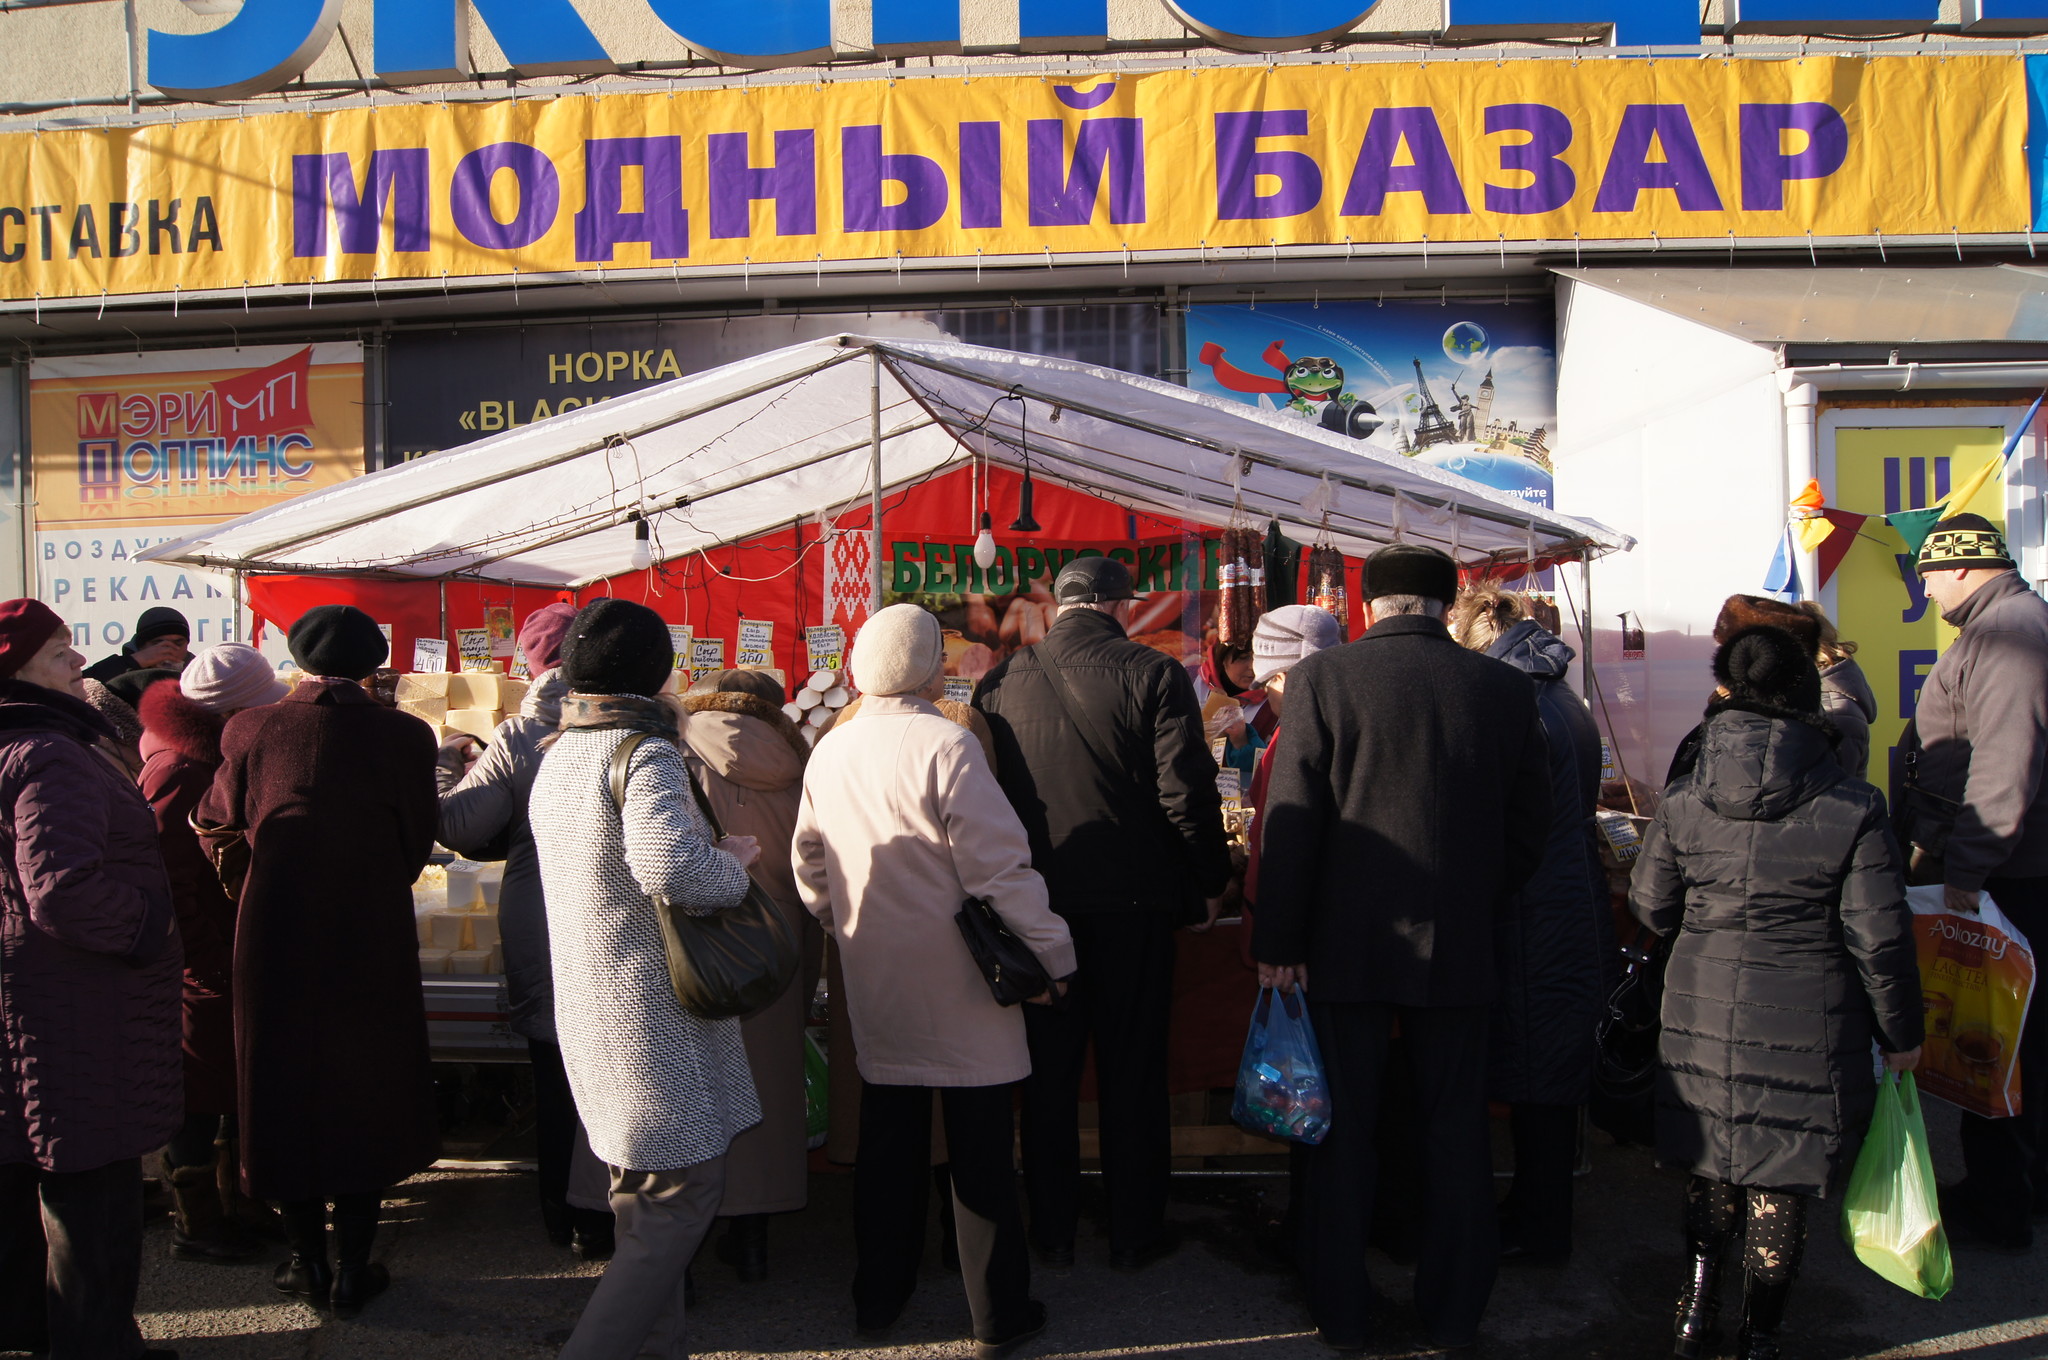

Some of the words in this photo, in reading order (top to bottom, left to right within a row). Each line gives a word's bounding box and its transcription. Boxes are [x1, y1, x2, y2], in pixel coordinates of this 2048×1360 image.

[292, 83, 1147, 262] МОДНЫЙ
[1214, 102, 1849, 221] БАЗАР
[549, 348, 683, 384] НОРКА
[77, 390, 217, 439] МЭРИ
[78, 433, 314, 486] ПОППИНС
[737, 651, 764, 665] 360
[813, 656, 837, 670] 185
